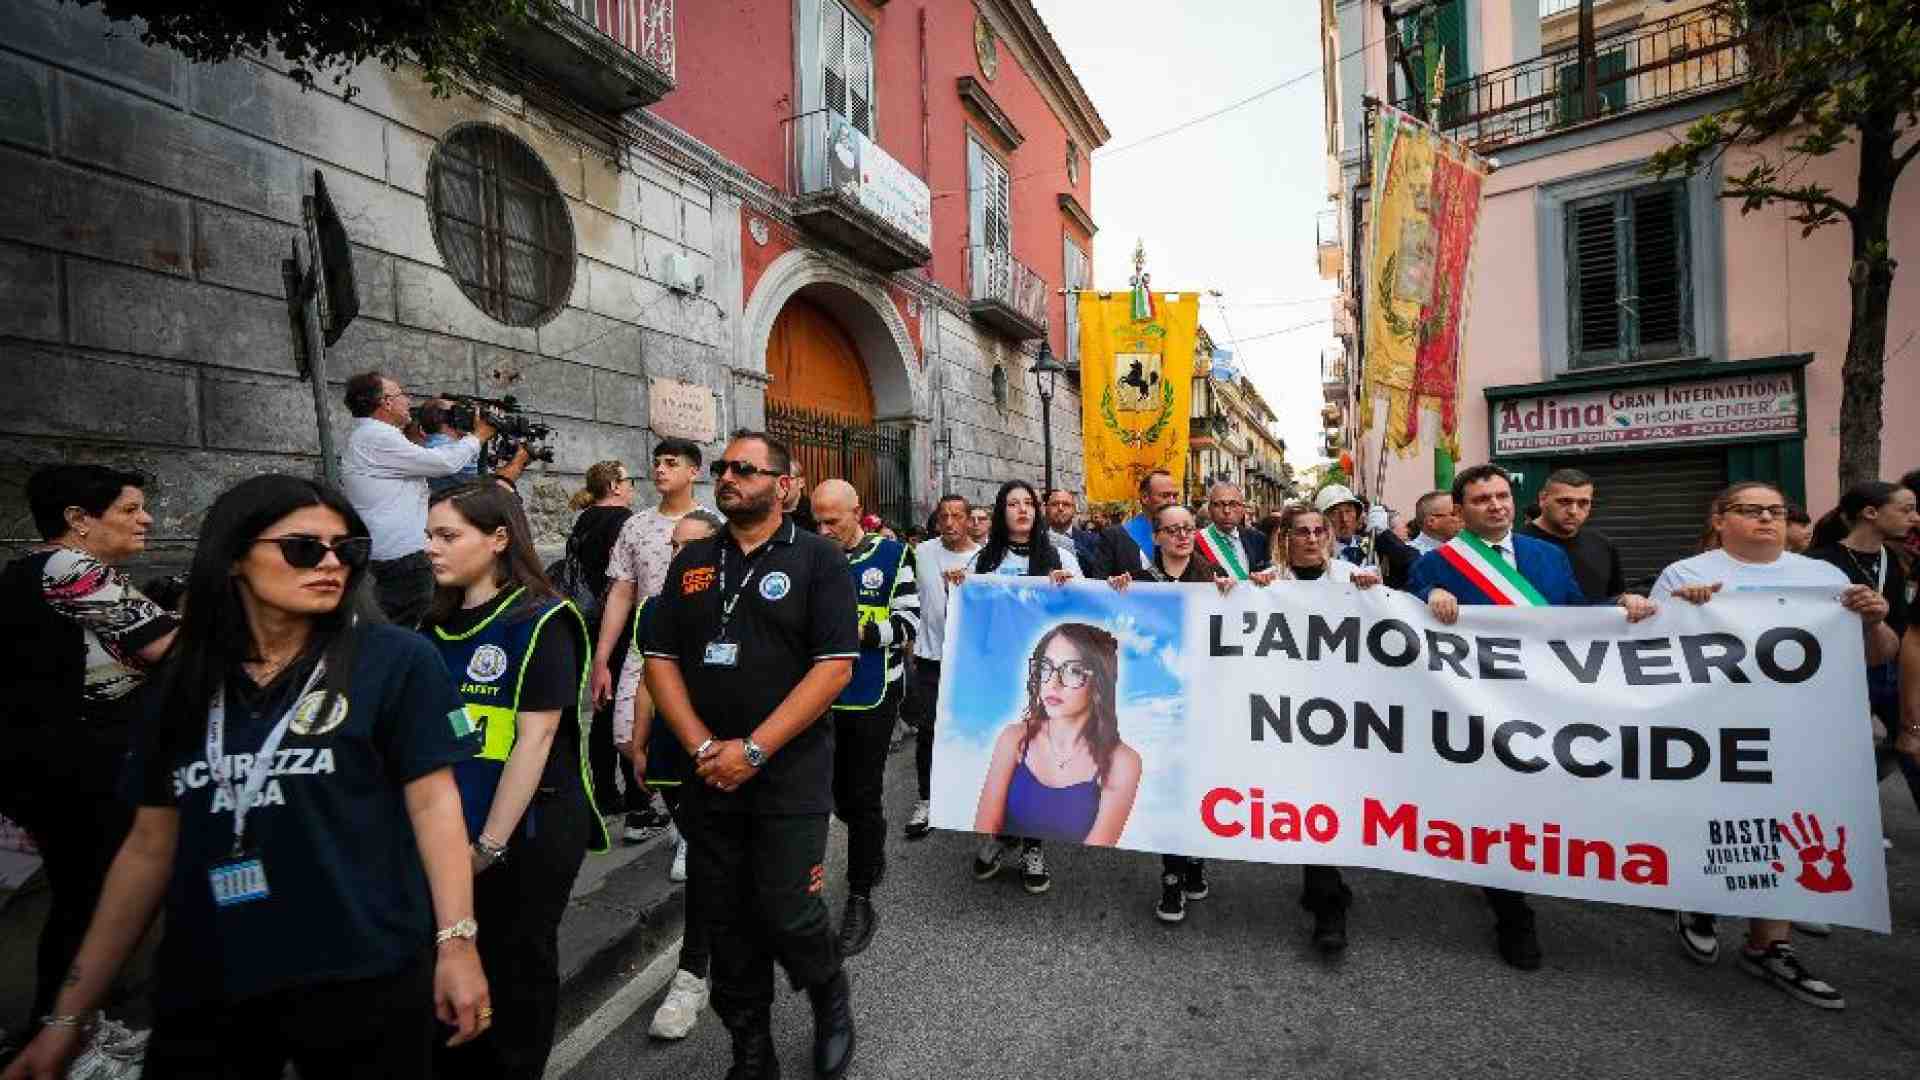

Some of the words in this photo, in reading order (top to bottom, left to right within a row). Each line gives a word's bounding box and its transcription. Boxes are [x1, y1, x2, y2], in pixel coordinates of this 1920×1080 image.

[1665, 379, 1790, 406] INTERNATIONA
[1501, 399, 1604, 432] Adina
[1635, 407, 1695, 424] PHONE
[1702, 400, 1769, 418] CENTER
[1501, 434, 1572, 449] INTERNET
[1577, 430, 1625, 443] POINT
[1643, 426, 1675, 438] FAX
[1209, 611, 1528, 680] L'AMORE
[1547, 627, 1823, 685] VERO
[1250, 693, 1404, 753] NON
[1431, 709, 1773, 784] UCCIDE
[173, 748, 336, 796] SICURZZA
[1200, 787, 1340, 843] Ciao
[1362, 797, 1670, 886] Martina
[1708, 818, 1781, 844] BASTA
[1706, 844, 1780, 864] VIOLENZA
[1725, 874, 1780, 891] DONNE
